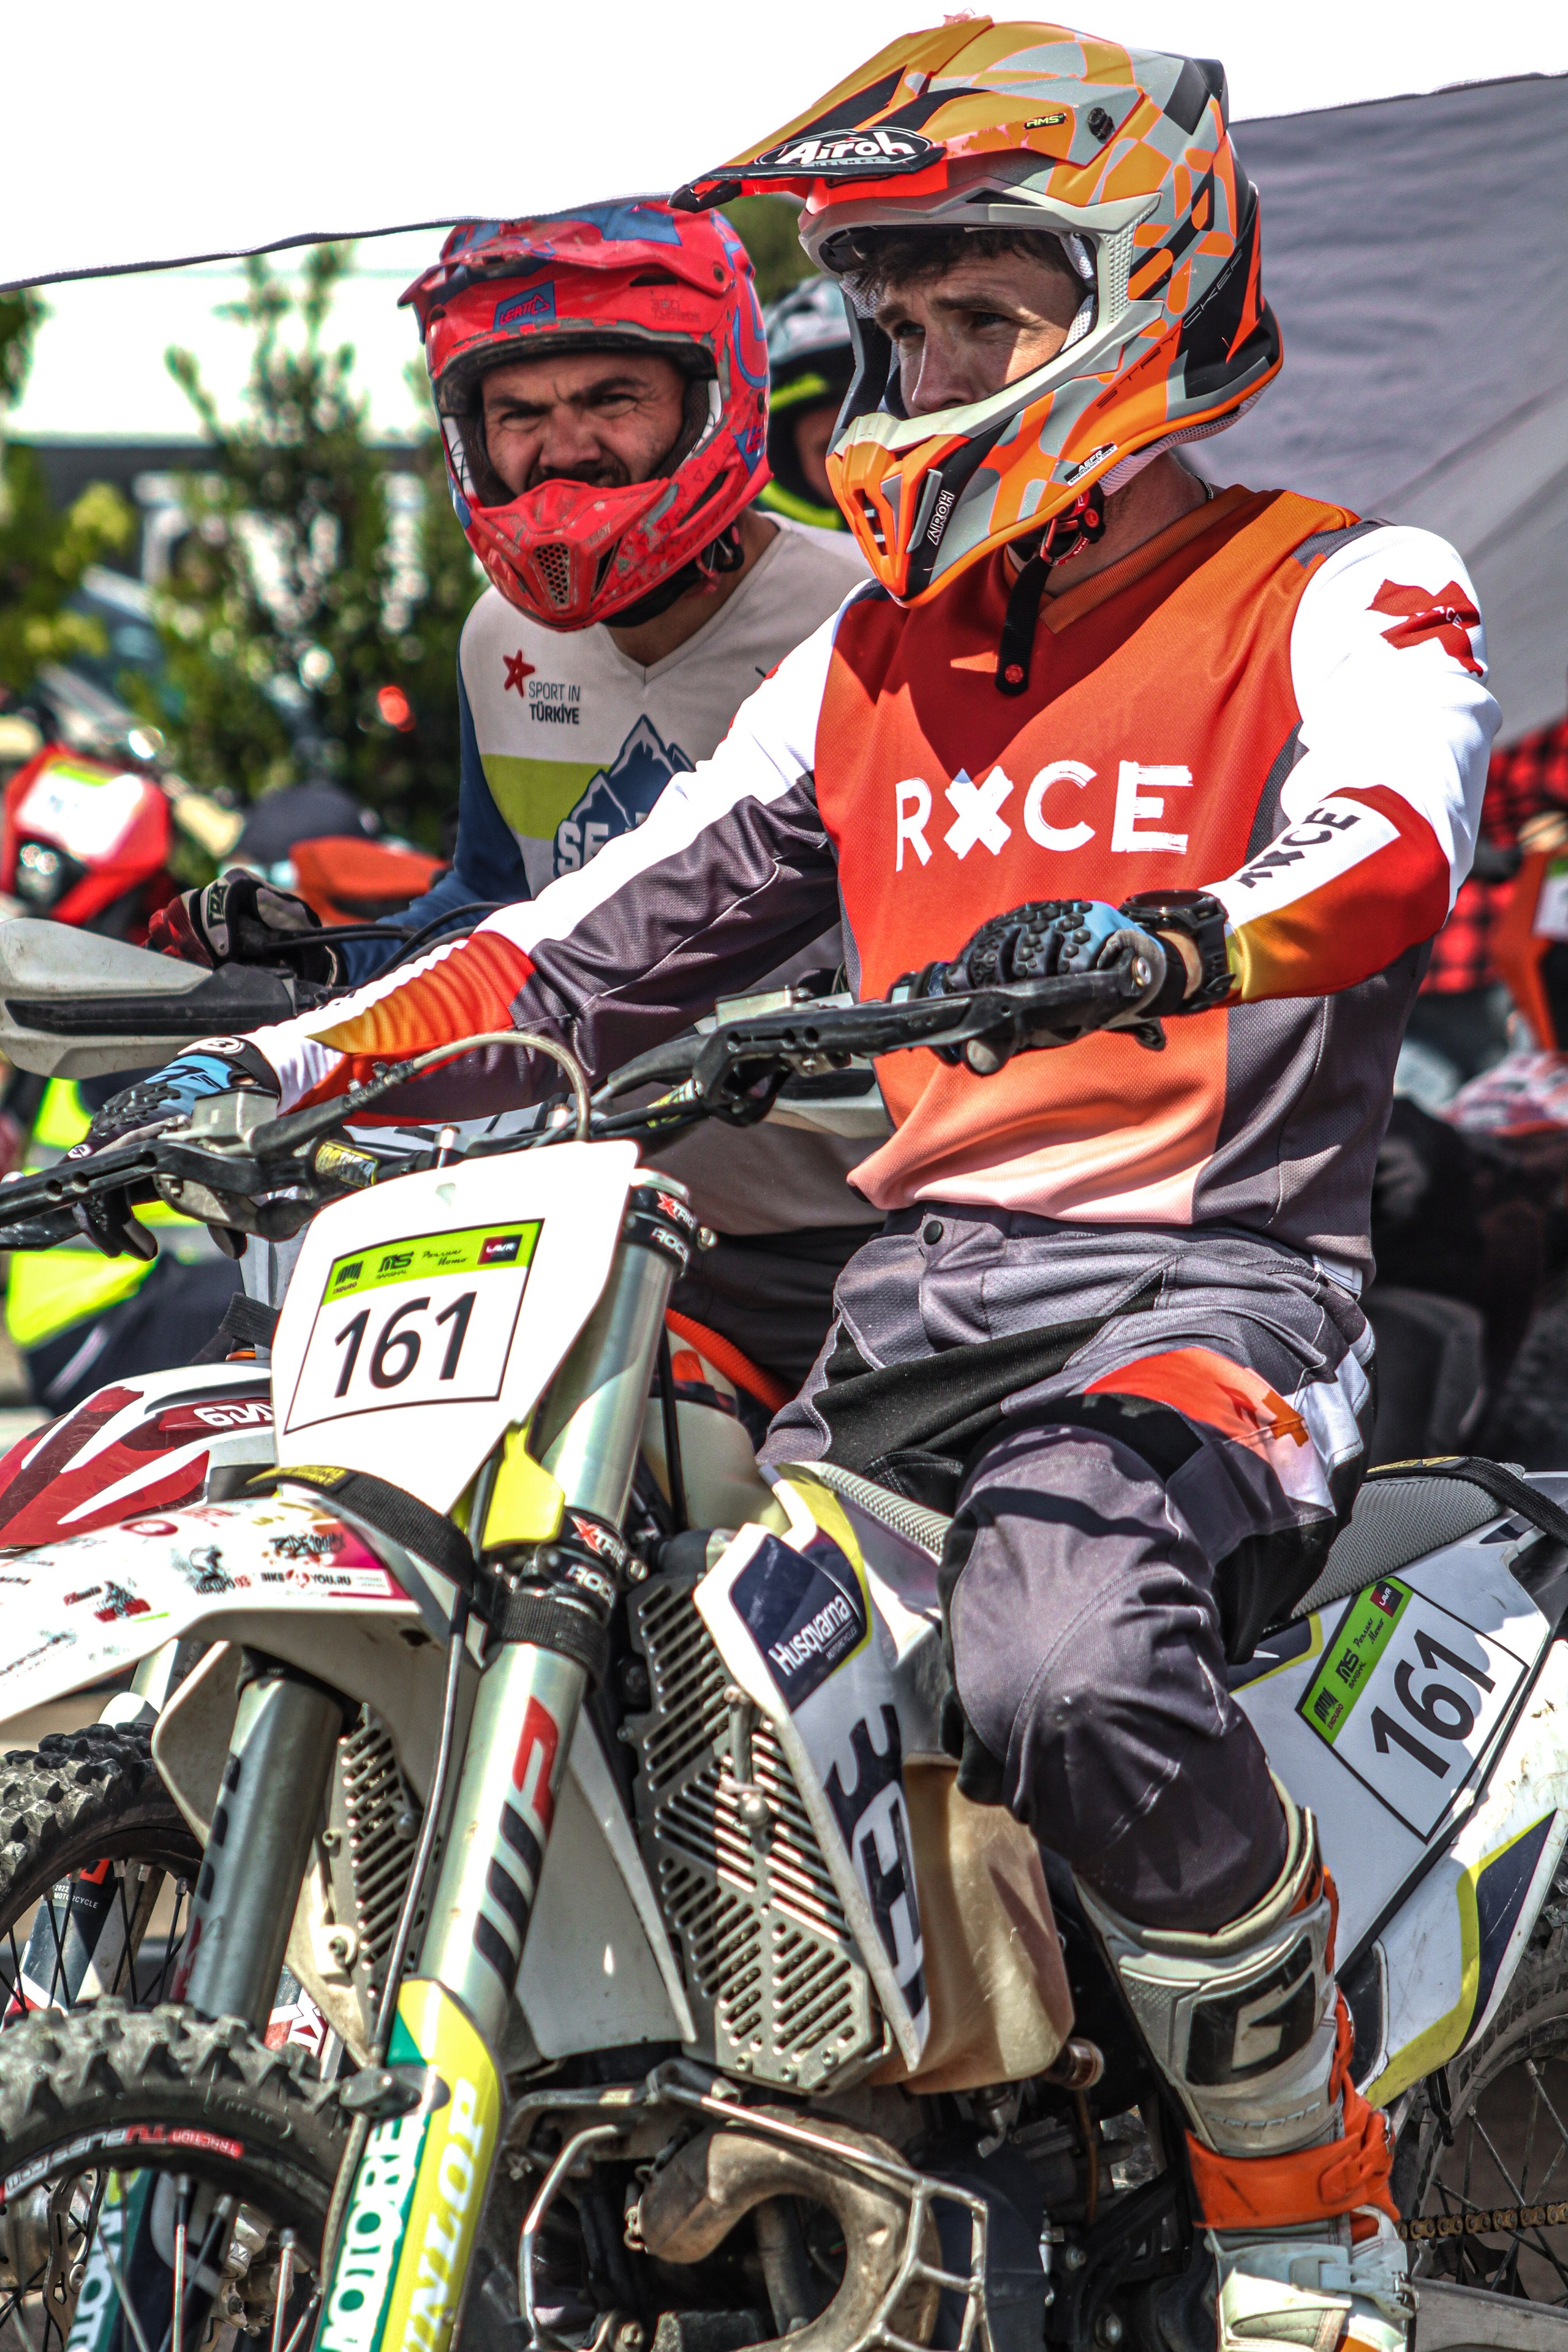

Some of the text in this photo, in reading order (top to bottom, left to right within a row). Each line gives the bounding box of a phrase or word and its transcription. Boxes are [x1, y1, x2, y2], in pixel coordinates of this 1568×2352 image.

[1069, 446, 1115, 483] EMERGENCY ONLY
[927, 489, 955, 546] AIROH
[529, 681, 580, 702] SPORT IN
[529, 701, 579, 725] TÜRKİYE
[334, 1291, 477, 1398] 161
[1379, 1587, 1392, 1607] LAVR
[767, 1594, 853, 1677] Husqvarna
[826, 1624, 858, 1662] MOTORCYCLES
[1348, 1661, 1366, 1690] MARSHAL
[1327, 1703, 1344, 1731] ENDURO
[1371, 1629, 1496, 1779] 161
[54, 1885, 69, 1893] 2022
